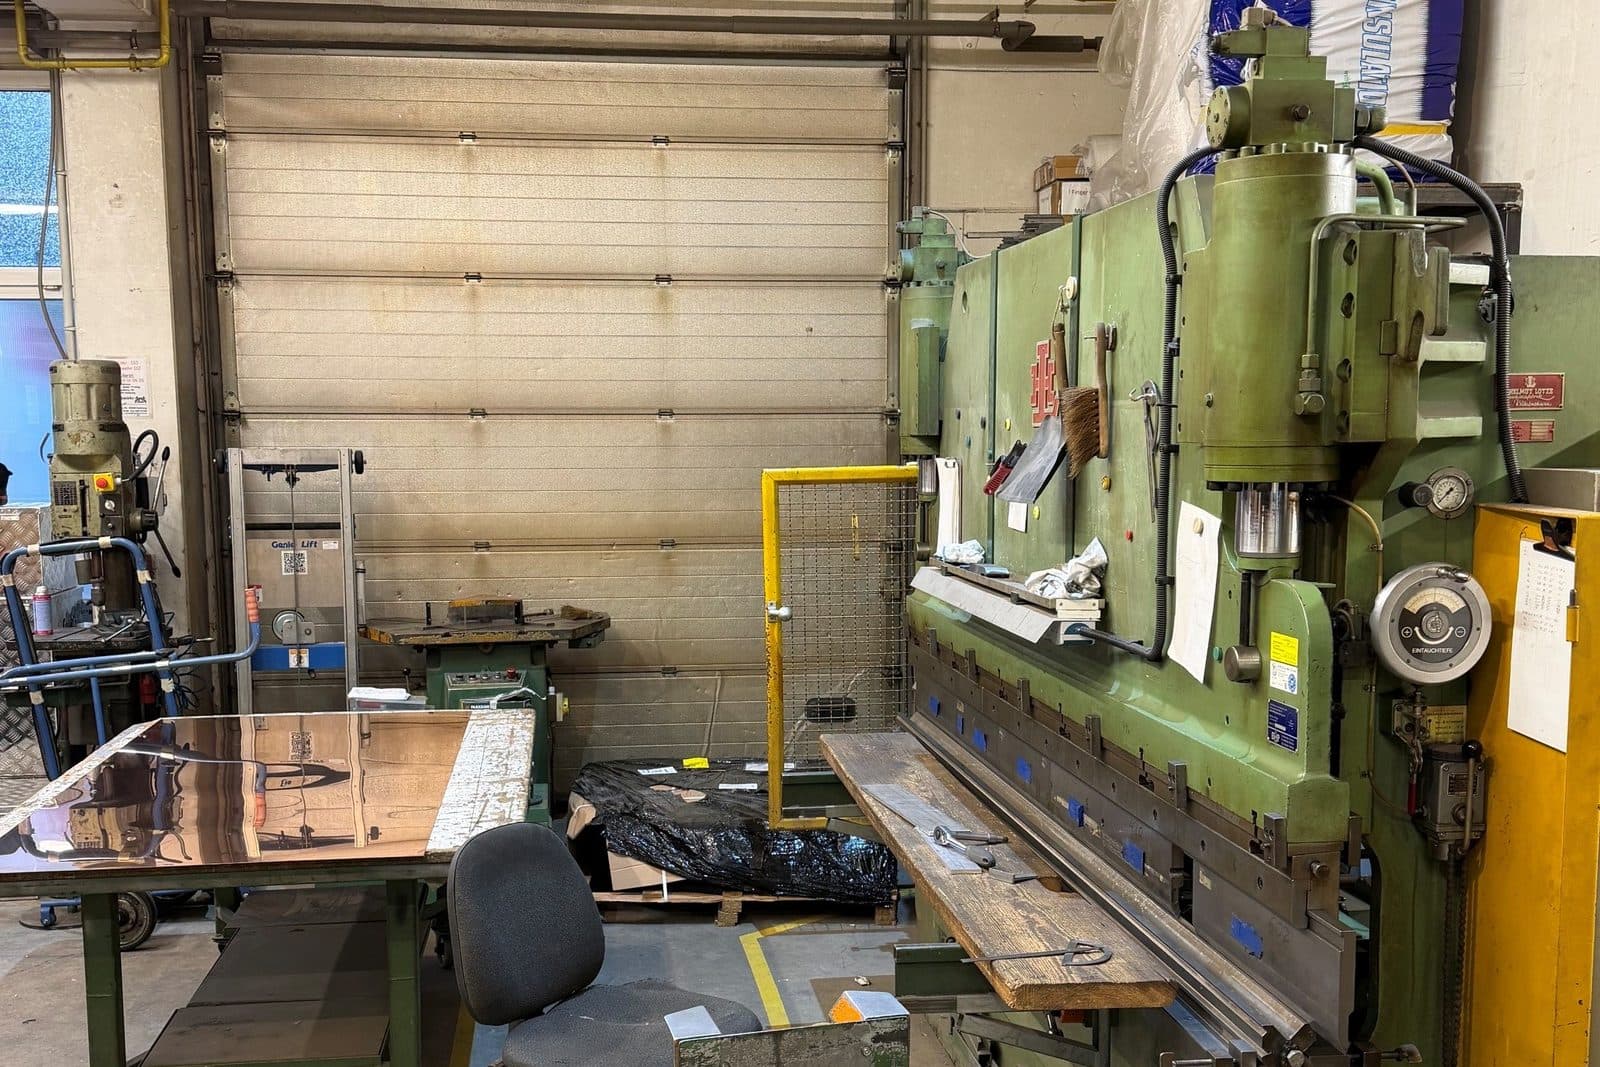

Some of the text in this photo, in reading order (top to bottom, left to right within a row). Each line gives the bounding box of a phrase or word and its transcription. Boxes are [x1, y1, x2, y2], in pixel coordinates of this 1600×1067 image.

[1357, 0, 1397, 107] NSULATIO
[301, 540, 318, 548] Lift
[1411, 647, 1454, 655] EINTAUCHTIEFE
